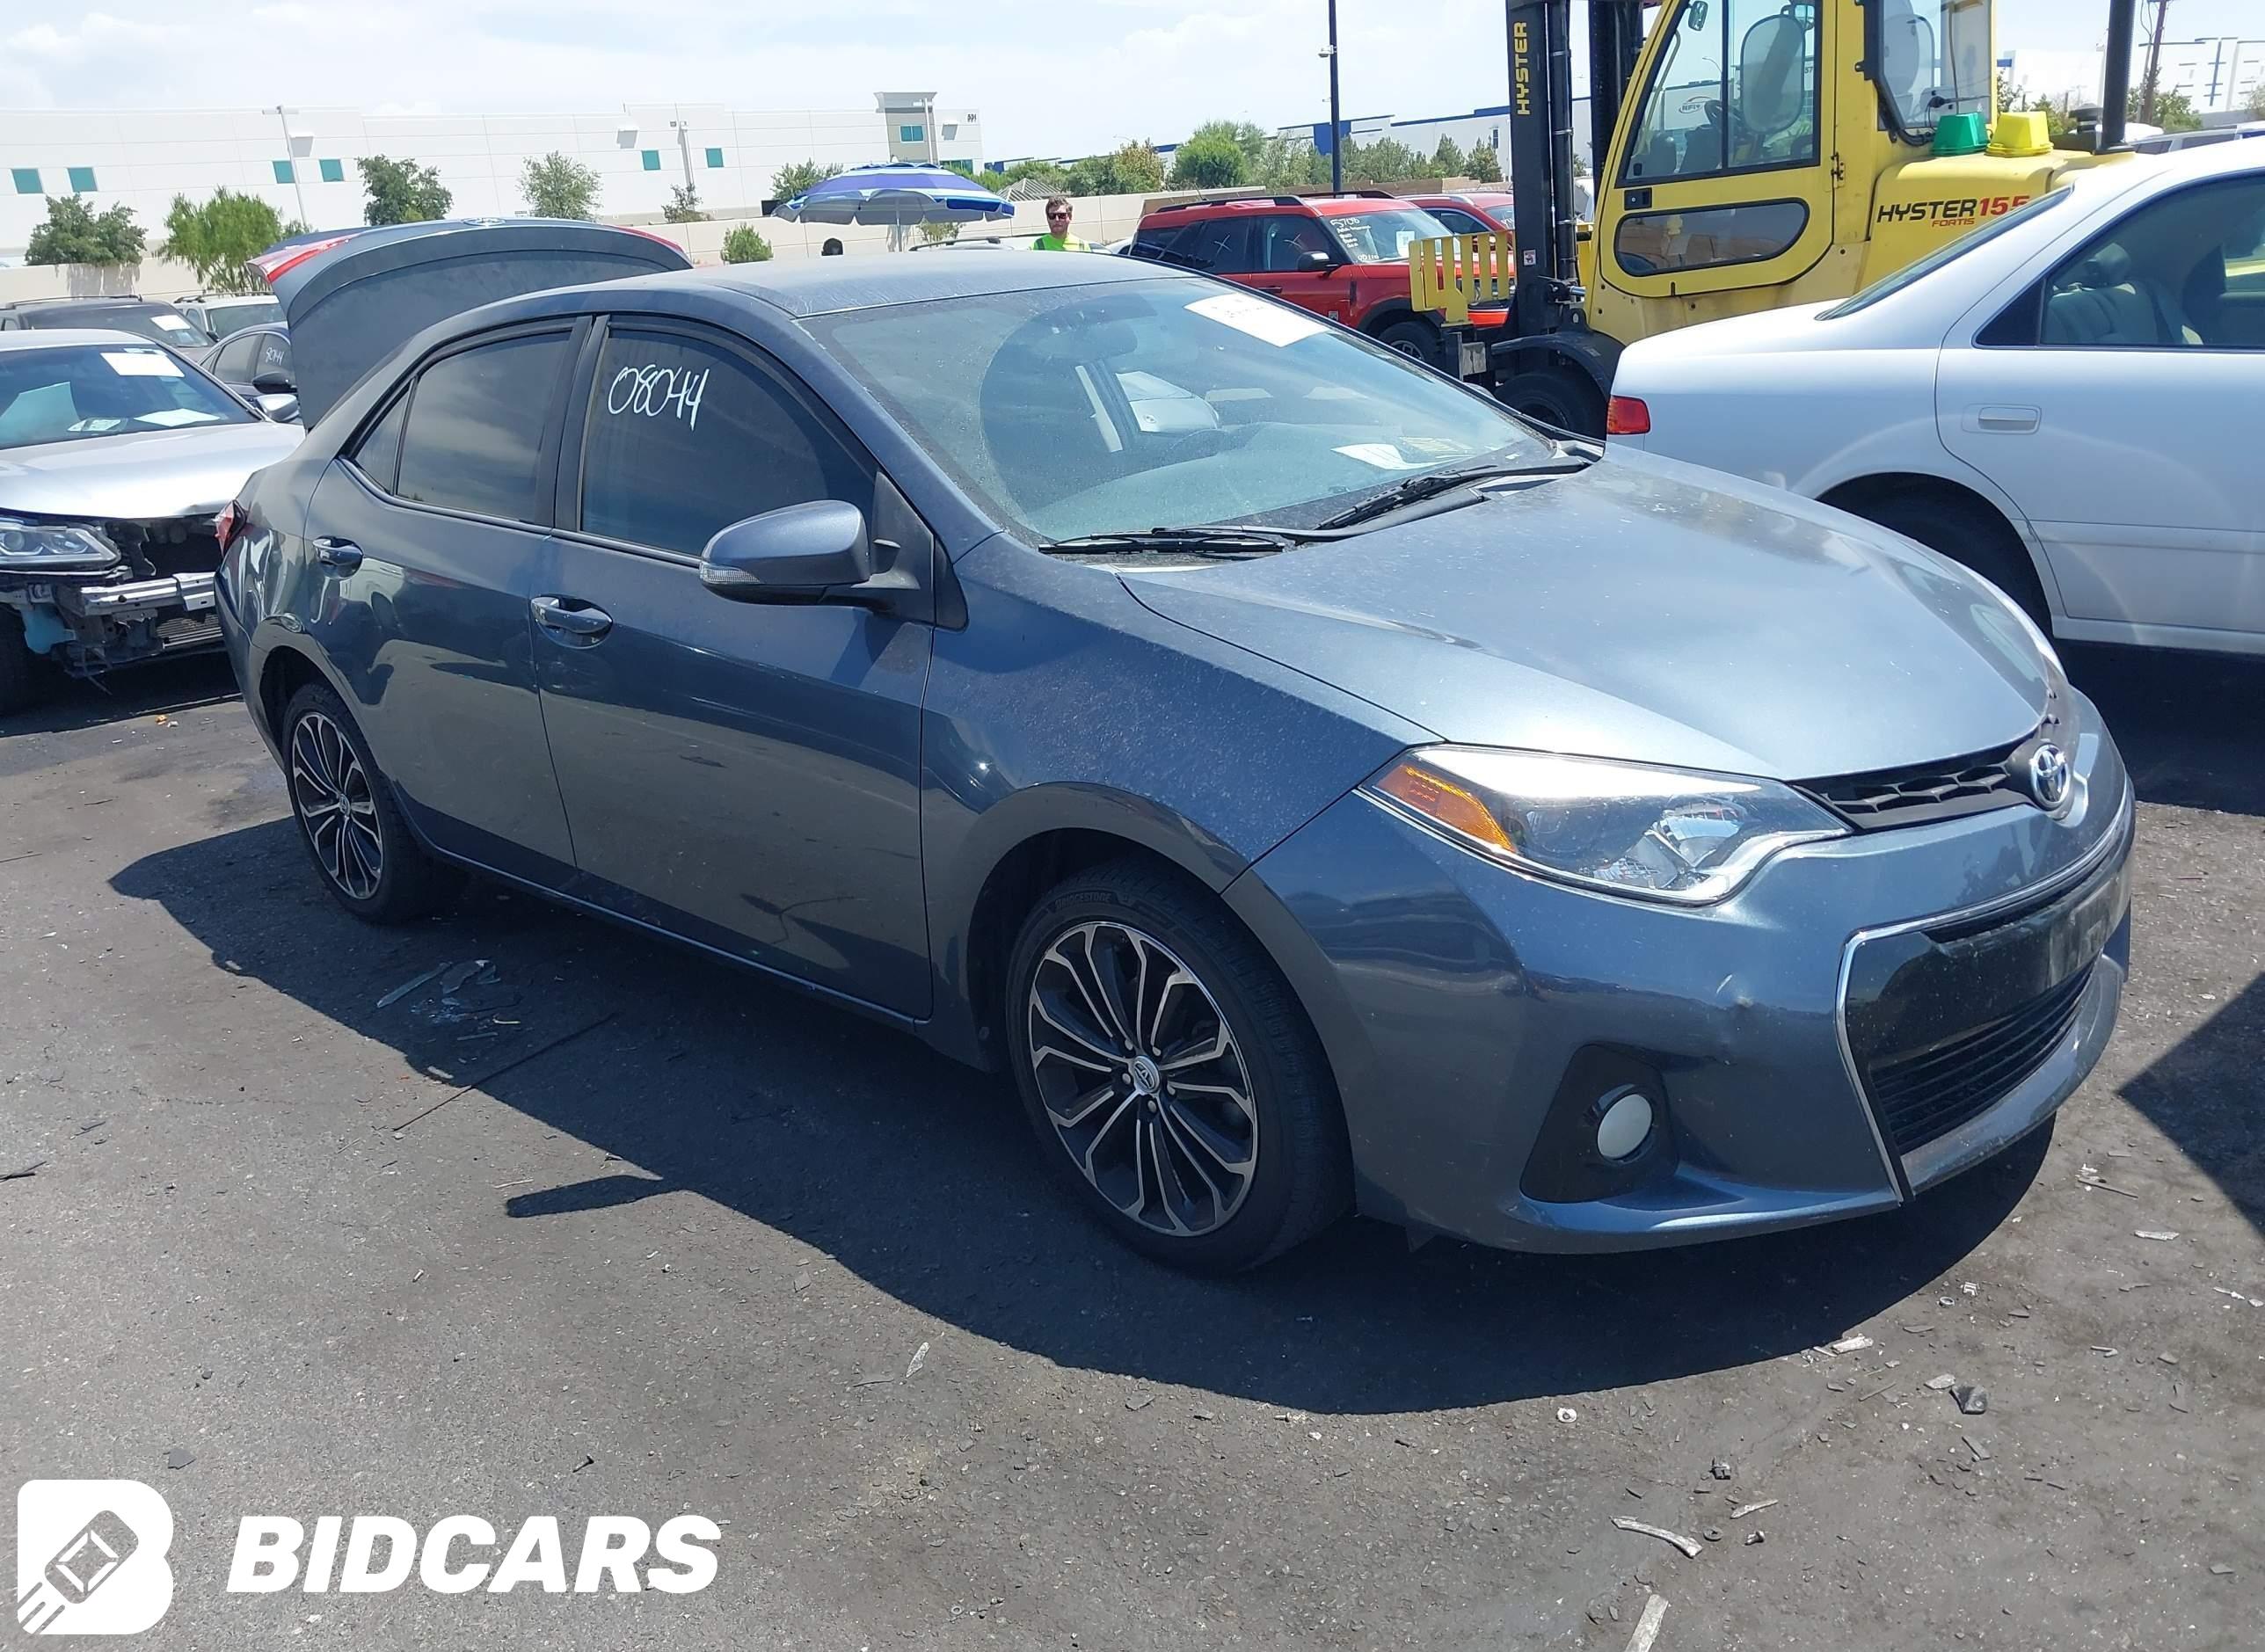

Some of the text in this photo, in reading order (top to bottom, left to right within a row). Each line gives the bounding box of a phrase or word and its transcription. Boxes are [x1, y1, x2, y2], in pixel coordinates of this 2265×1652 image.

[1514, 22, 1530, 115] HYSTER
[1876, 199, 1977, 223] HYSTER
[1931, 217, 1976, 228] FORTIS
[608, 364, 710, 432] 08044
